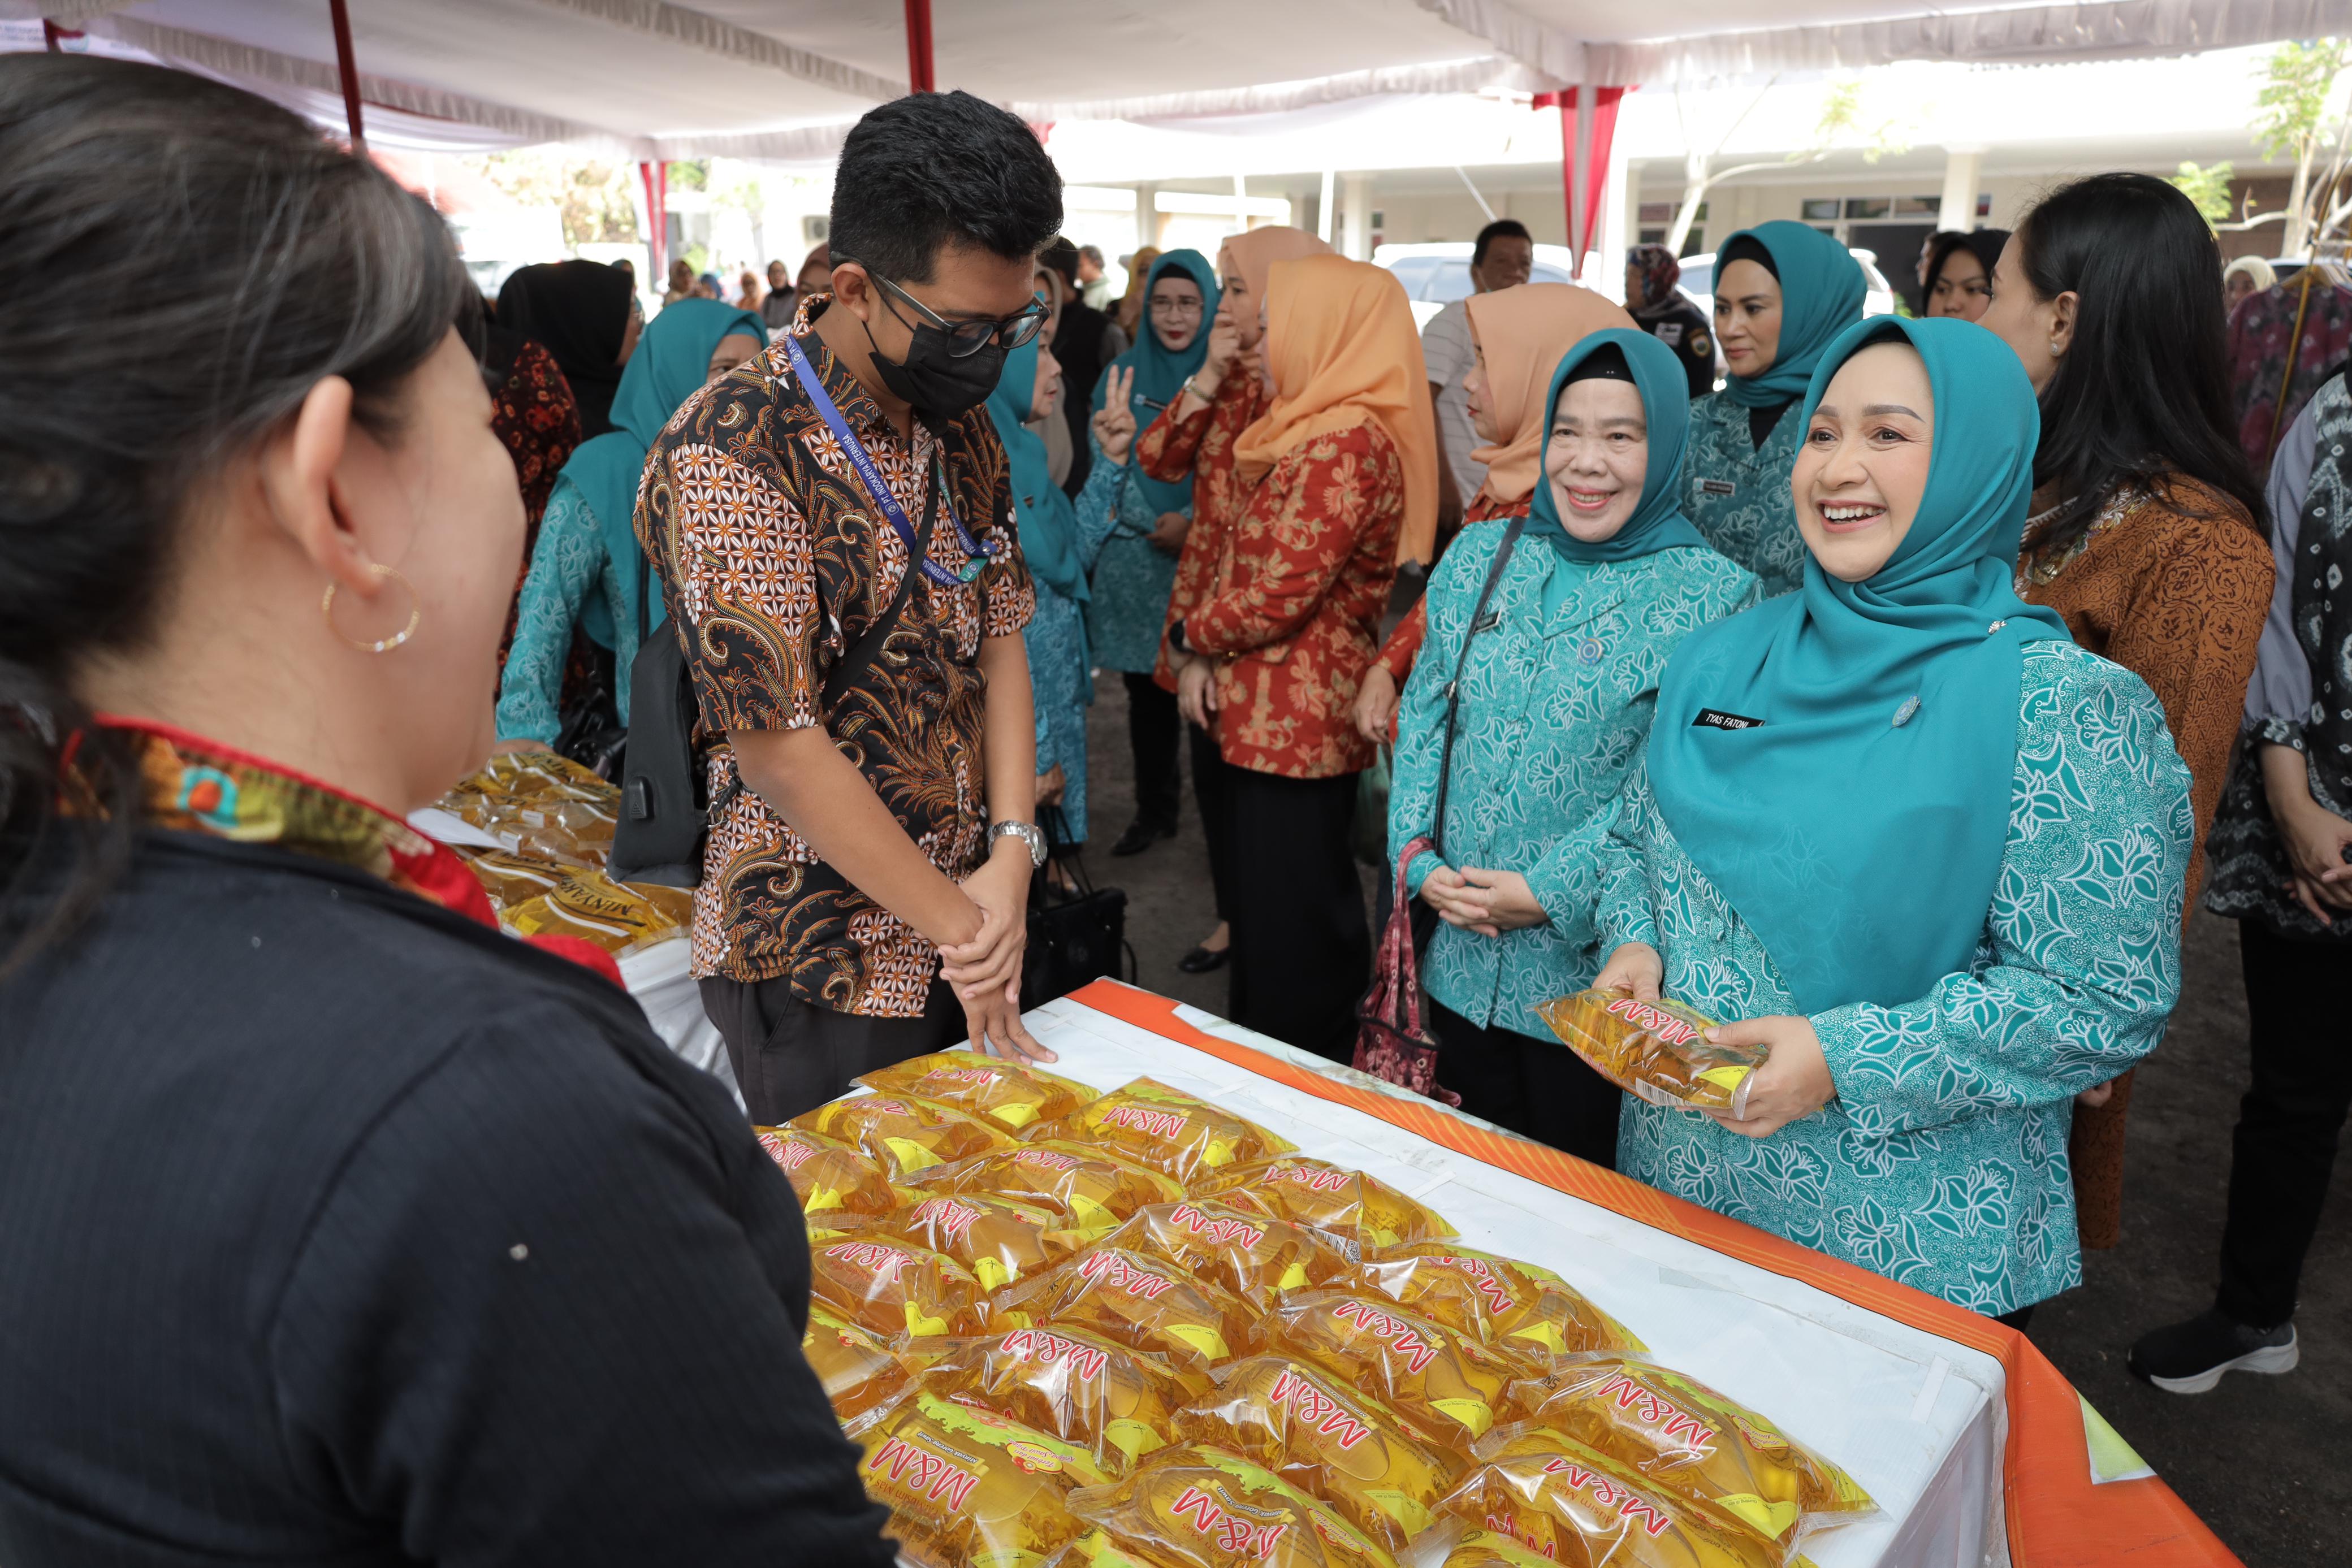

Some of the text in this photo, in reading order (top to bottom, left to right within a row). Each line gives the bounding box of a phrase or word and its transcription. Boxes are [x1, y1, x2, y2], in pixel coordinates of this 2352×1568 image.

[842, 433, 867, 466] INTERNUSA
[862, 464, 885, 496] INDOKARYA
[922, 557, 948, 581] INTERNUSA
[1706, 713, 1749, 729] TYAS FATONI
[560, 878, 633, 917] MINYAK
[1606, 998, 1701, 1045] M&M
[1101, 1107, 1188, 1140] M&M
[1168, 1205, 1264, 1251] M&M
[1079, 1250, 1175, 1300] M&M
[1494, 1266, 1513, 1287] Minyak
[1332, 1301, 1438, 1375] M&M
[1341, 1324, 1361, 1341] Mas
[999, 1329, 1109, 1384] M&M
[1268, 1370, 1371, 1451] M&M
[1594, 1375, 1716, 1454] M&M
[1681, 1404, 1709, 1421] Minyak
[932, 1439, 954, 1454] Goreng
[953, 1450, 979, 1464] Minyak
[1013, 1449, 1054, 1468] Terbuat dari
[1028, 1448, 1052, 1458] Sawit
[1051, 1453, 1076, 1463] Kelapa
[868, 1436, 980, 1514] M&M
[874, 1479, 893, 1493] Mas
[1216, 1485, 1285, 1518] Minyak Goreng Sawit
[1542, 1459, 1672, 1538] M&M
[1555, 1482, 1579, 1501] Mas
[1169, 1485, 1289, 1560] M&M
[1580, 1498, 1616, 1527] Musim
[1181, 1523, 1204, 1542] Mas
